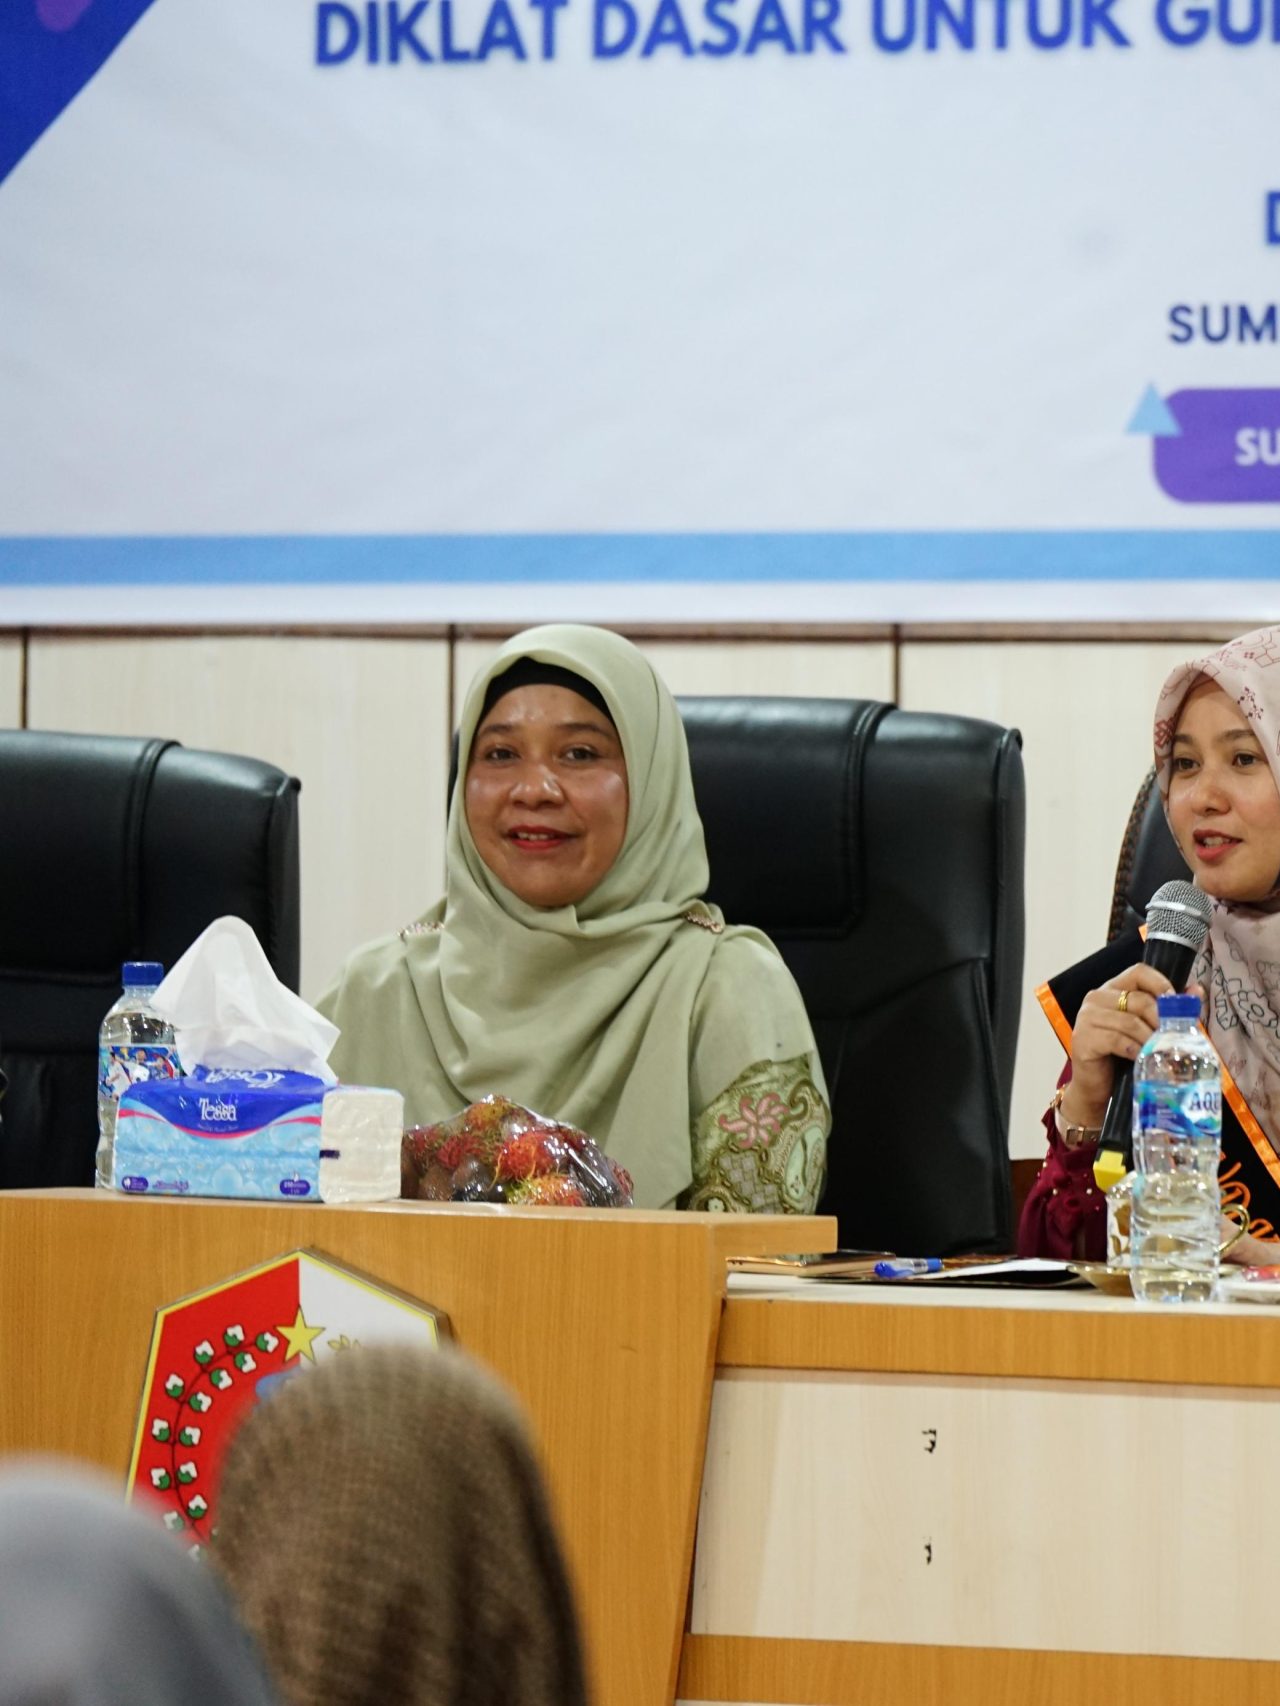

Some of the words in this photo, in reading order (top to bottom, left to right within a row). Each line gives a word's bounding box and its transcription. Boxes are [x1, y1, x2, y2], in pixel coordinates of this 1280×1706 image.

[314, 0, 570, 67] DIKLAT
[592, 0, 846, 61] DASAR
[870, 0, 1131, 55] UNTUK
[199, 1097, 238, 1121] Tessa
